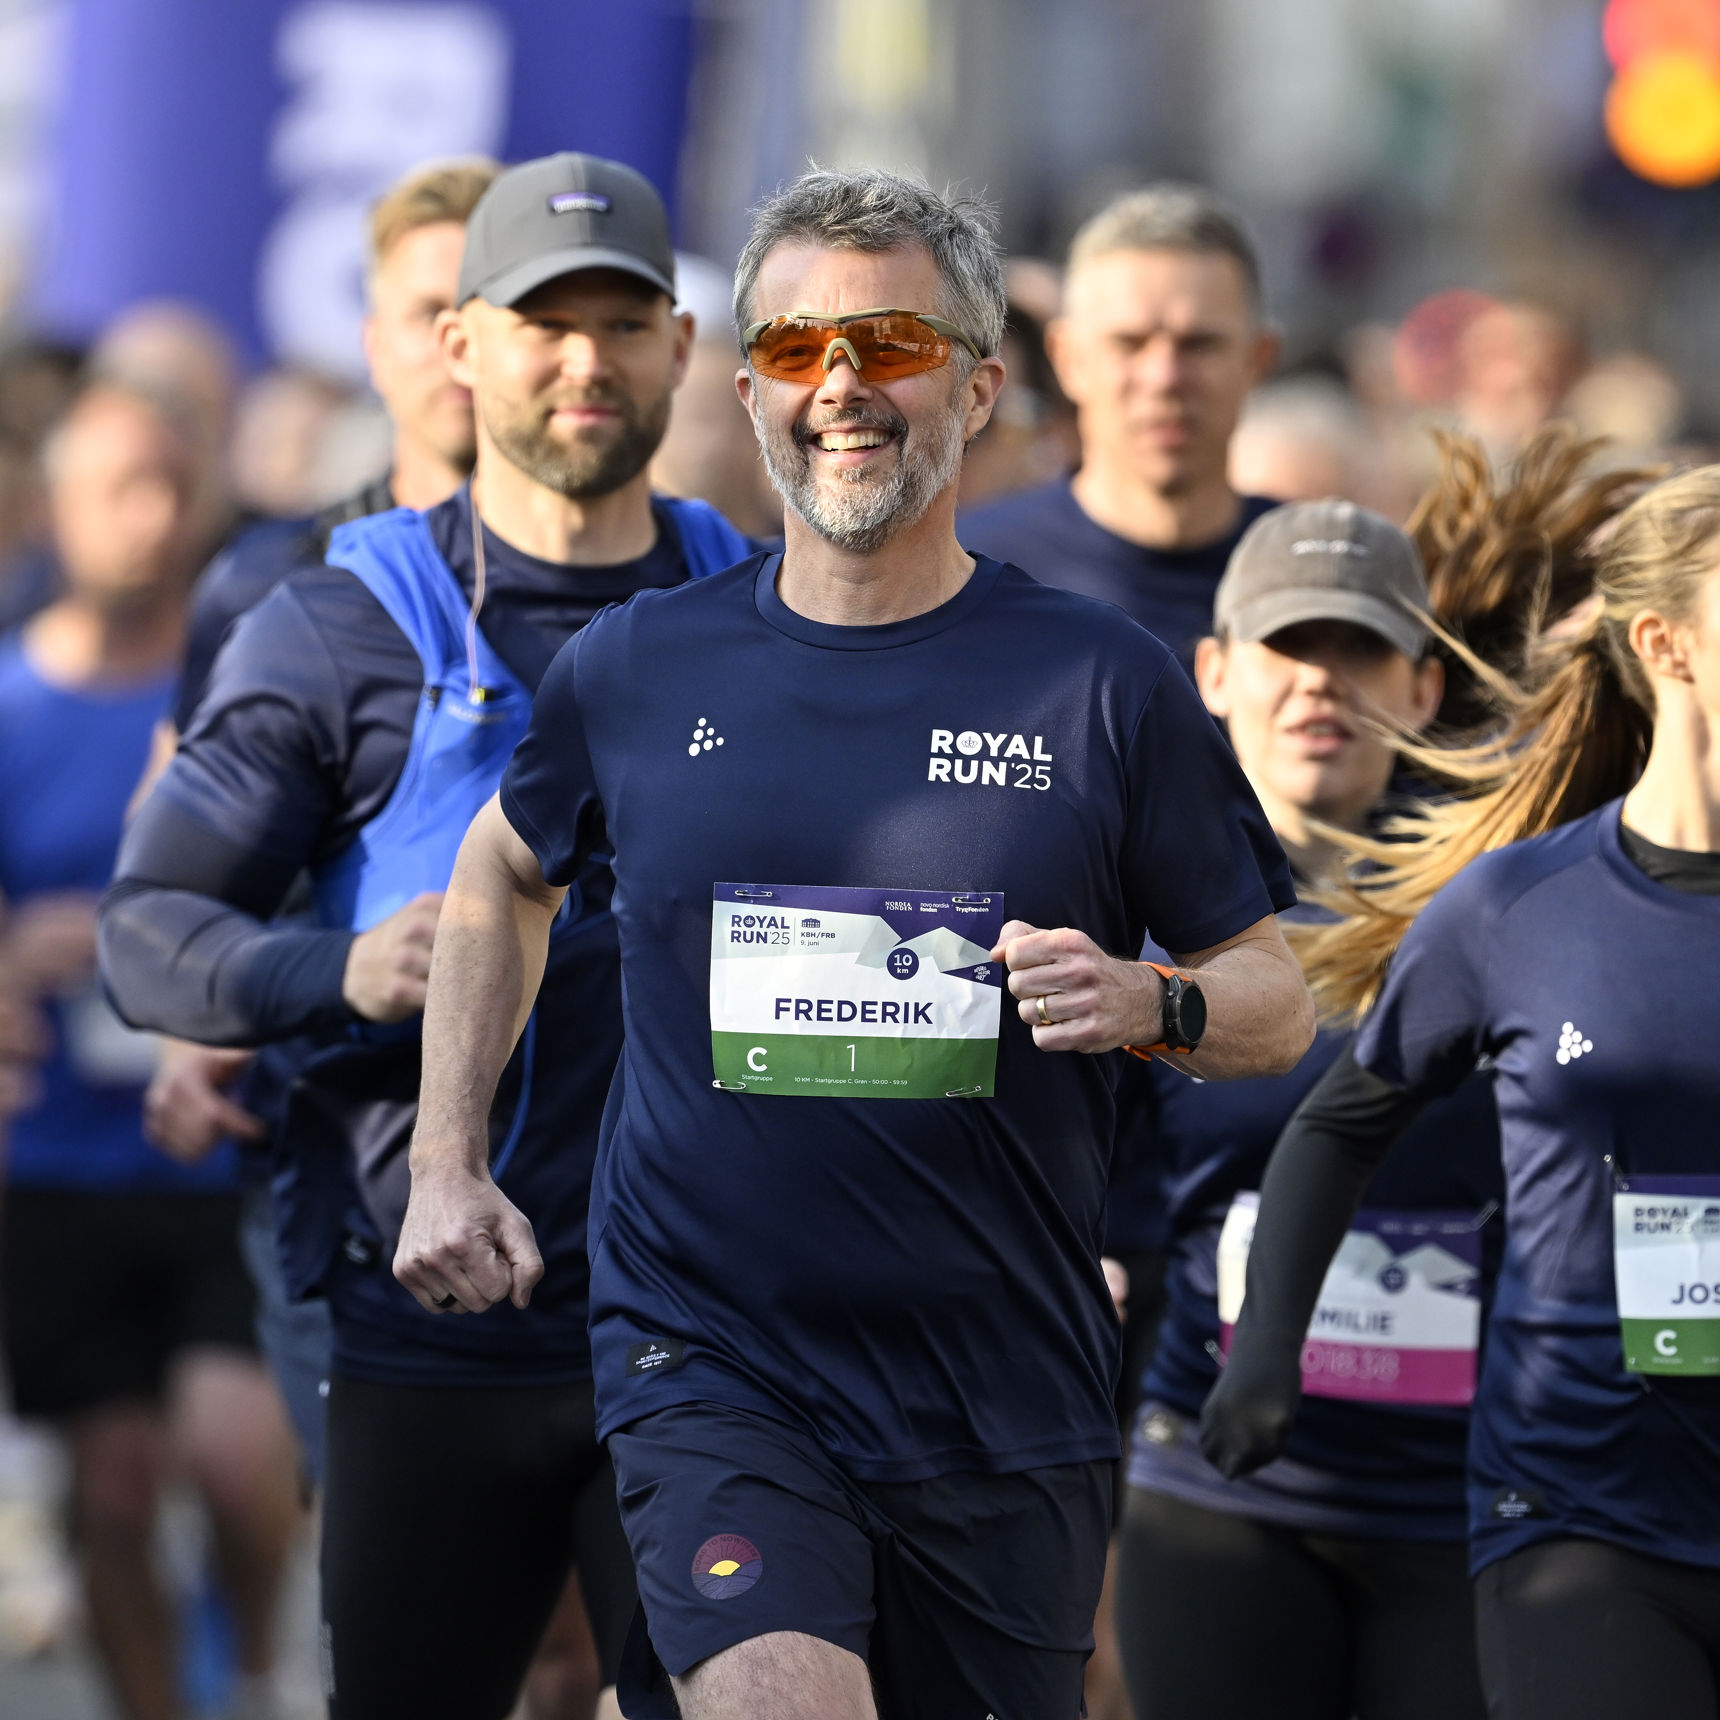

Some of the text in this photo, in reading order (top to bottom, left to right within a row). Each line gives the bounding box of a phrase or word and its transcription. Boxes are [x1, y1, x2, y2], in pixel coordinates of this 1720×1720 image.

[930, 729, 1053, 762] ROYAL
[731, 914, 790, 929] ROYAL
[807, 939, 820, 947] juni
[893, 954, 913, 966] 10
[774, 997, 934, 1025] FREDERIK
[746, 1046, 768, 1073] C
[846, 1043, 856, 1072] 1
[741, 1074, 774, 1083] Startgruppe
[814, 1077, 847, 1085] Startgruppe
[1315, 1309, 1393, 1336] MILIE
[1653, 1329, 1678, 1356] C
[707, 1538, 718, 1548] TO
[720, 1535, 758, 1558] NOWHERE
